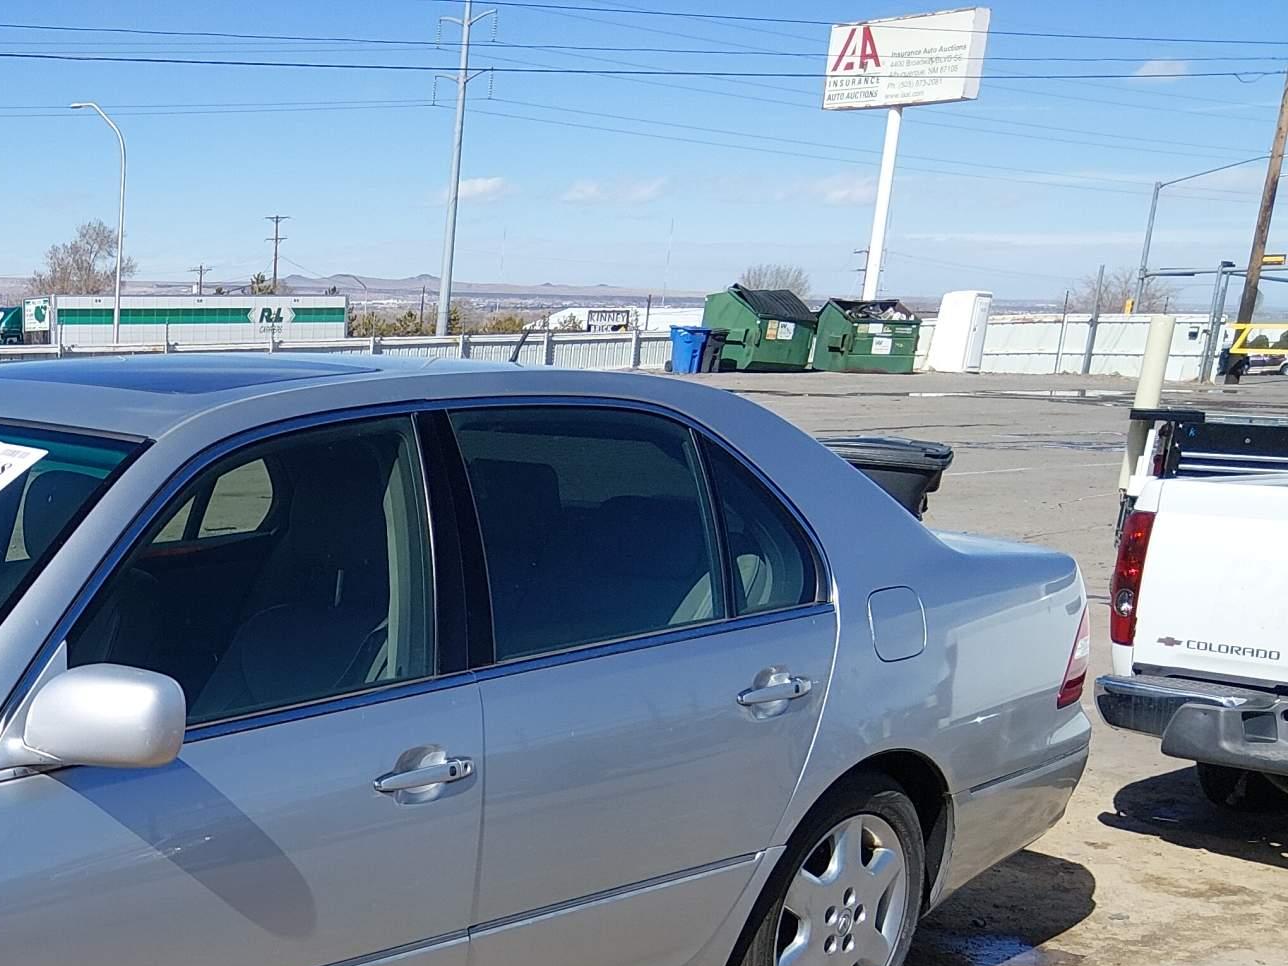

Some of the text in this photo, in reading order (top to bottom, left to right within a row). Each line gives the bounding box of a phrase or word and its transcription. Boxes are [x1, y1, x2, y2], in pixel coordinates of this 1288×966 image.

[891, 43, 967, 58] Insurance Auto Auctions
[828, 76, 881, 88] INSURANCE
[827, 89, 879, 101] AUTO AUCTIONS
[589, 311, 627, 323] KINNEY
[1186, 639, 1281, 661] COLORADO
